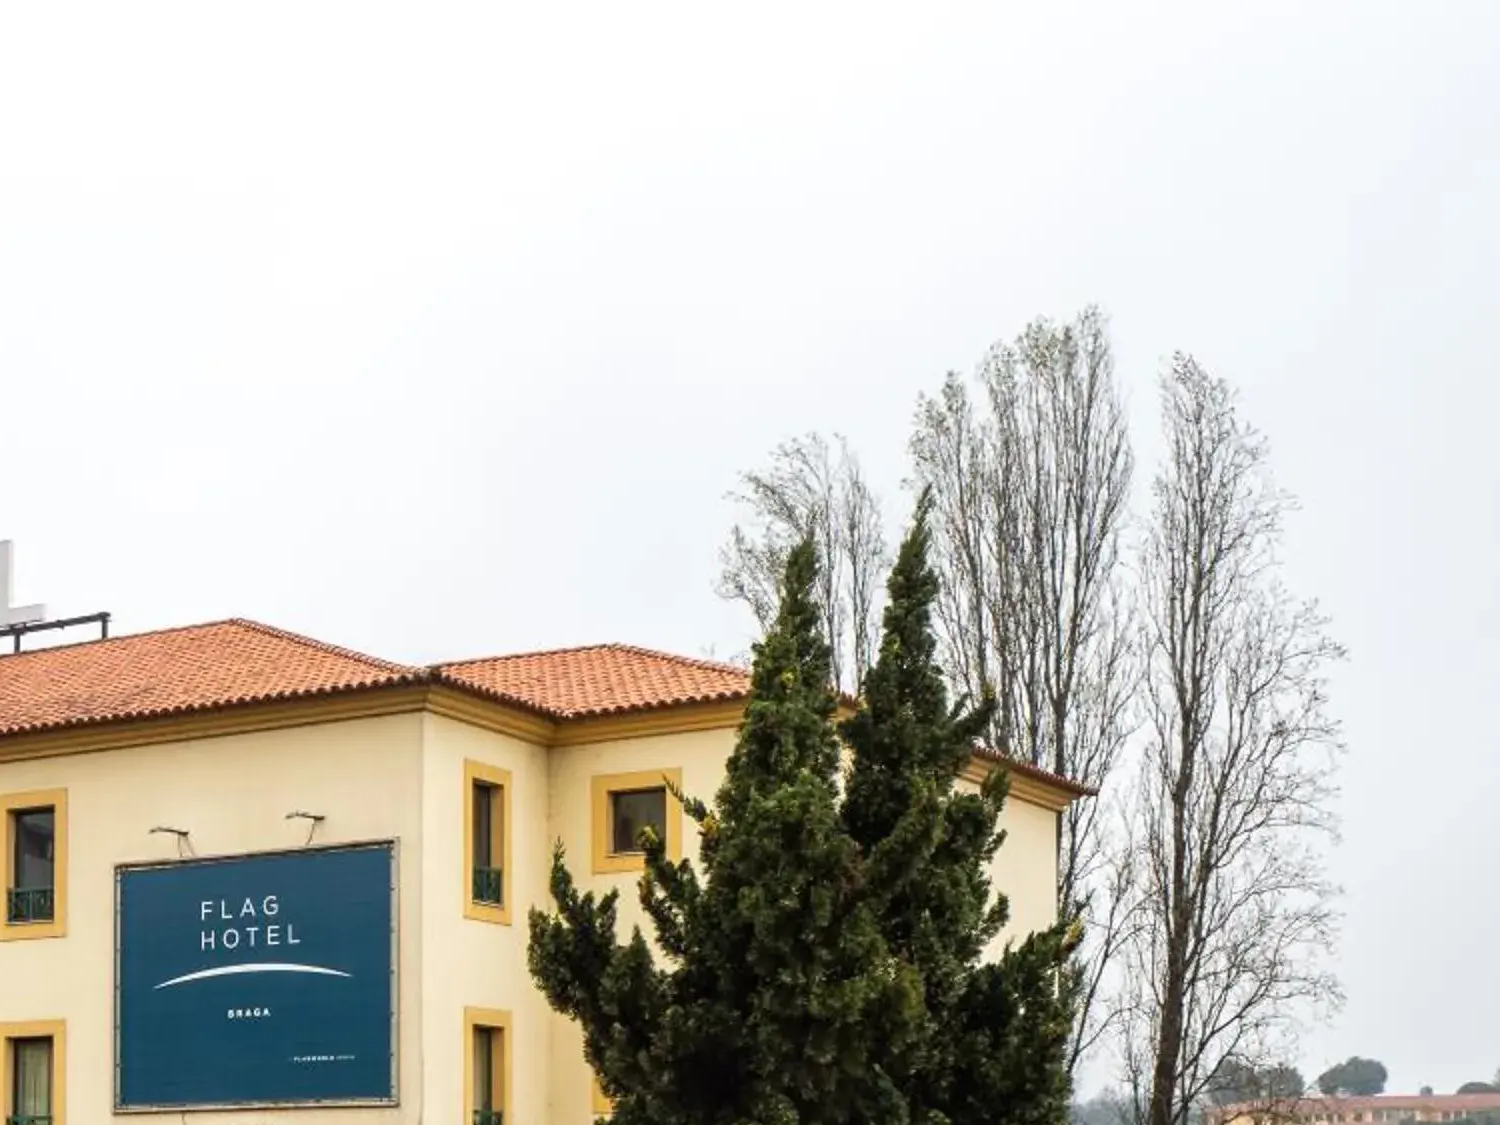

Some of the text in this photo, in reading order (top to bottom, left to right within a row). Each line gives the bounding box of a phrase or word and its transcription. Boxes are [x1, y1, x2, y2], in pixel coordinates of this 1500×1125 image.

[201, 895, 279, 920] FLAG
[201, 923, 301, 950] HOTEL
[227, 1007, 271, 1019] BRAGA
